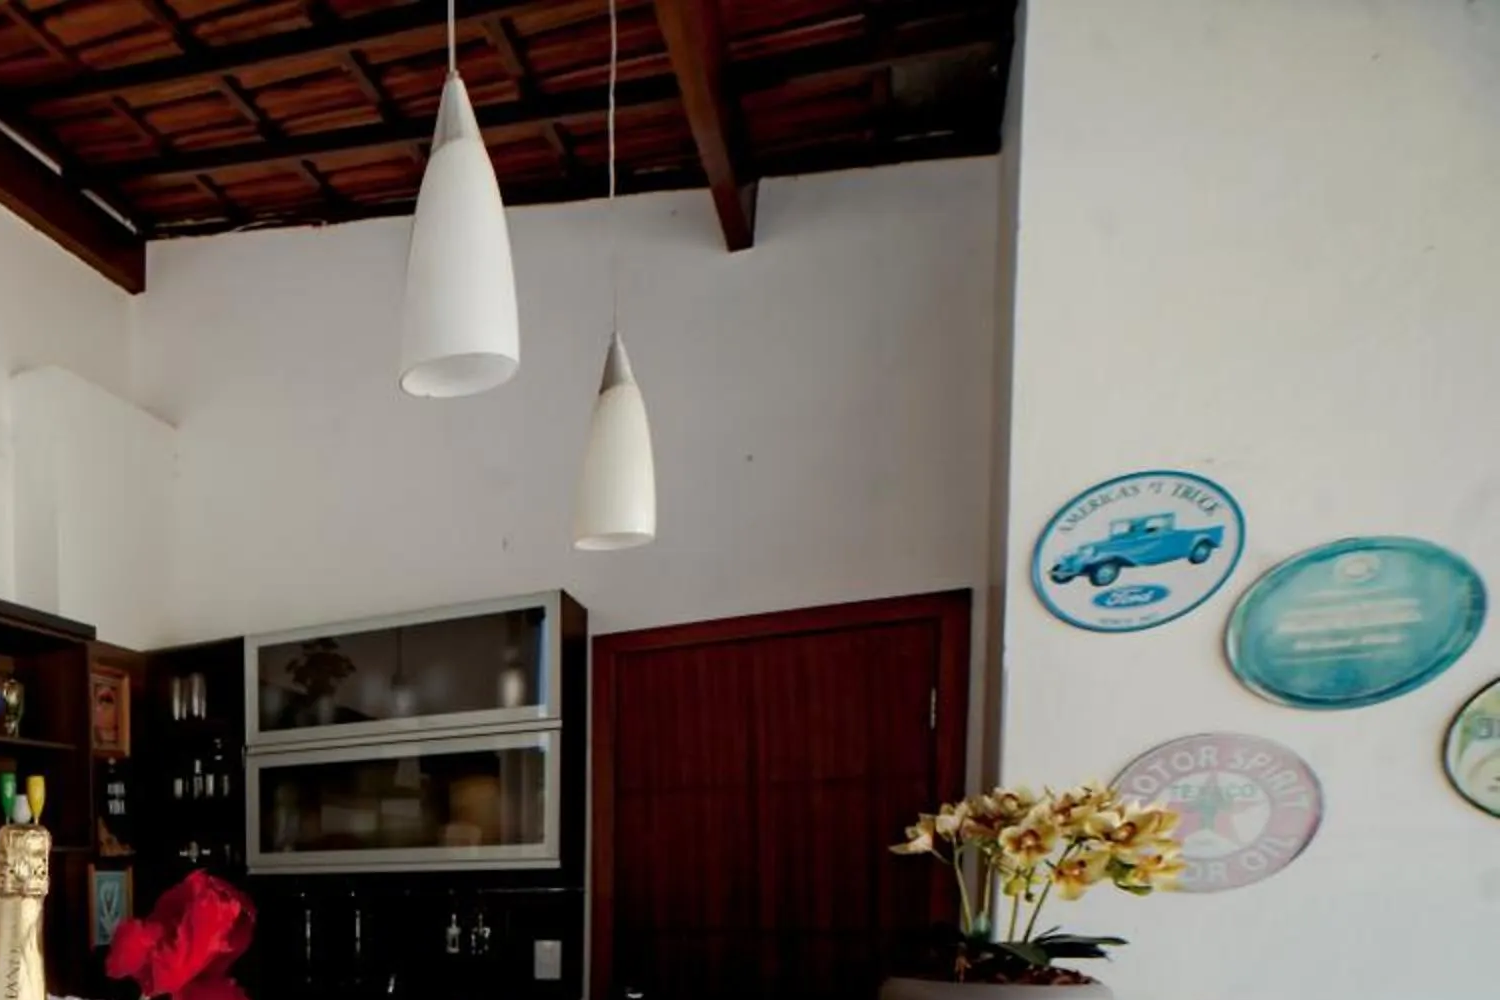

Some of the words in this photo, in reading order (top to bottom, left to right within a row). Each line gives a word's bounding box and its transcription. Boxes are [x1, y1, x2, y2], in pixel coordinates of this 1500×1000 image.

[1171, 483, 1221, 516] TRUCK
[1227, 752, 1309, 809] SPIRIT
[1239, 836, 1298, 871] OIL
